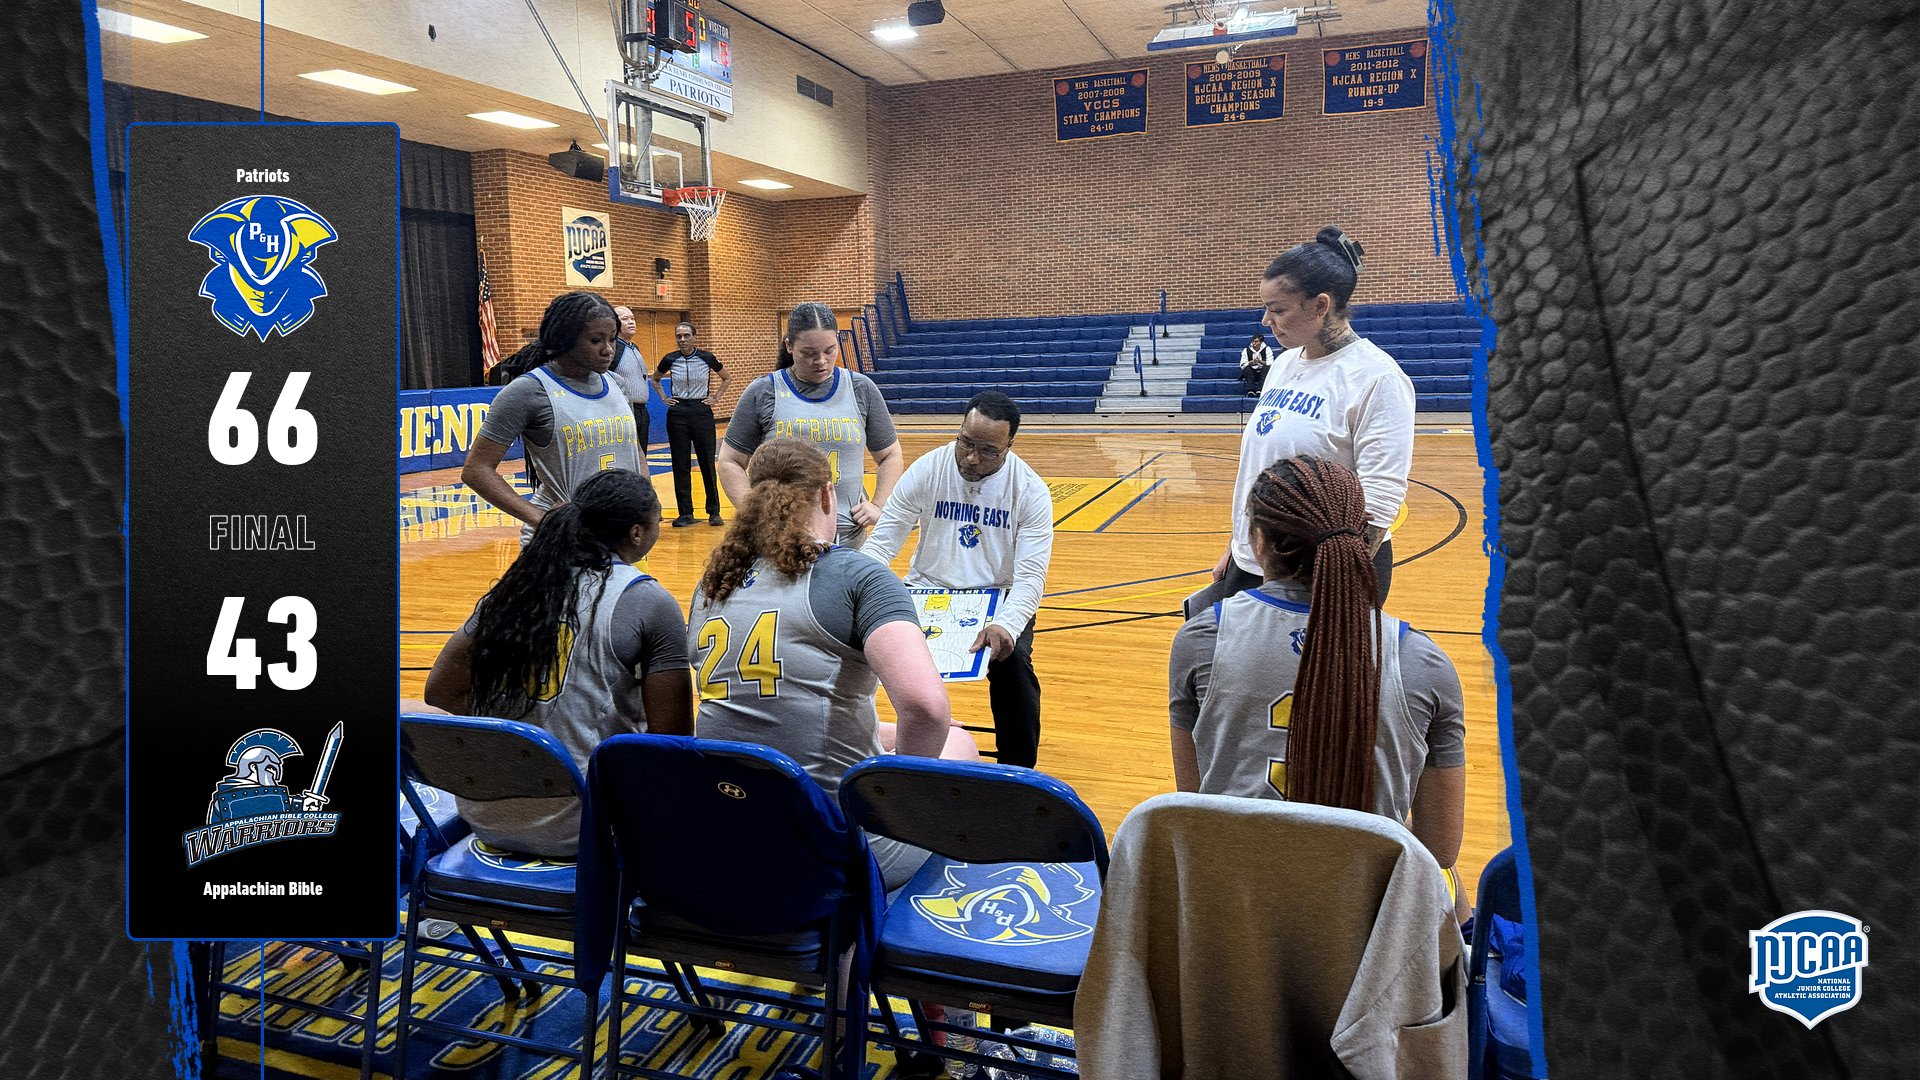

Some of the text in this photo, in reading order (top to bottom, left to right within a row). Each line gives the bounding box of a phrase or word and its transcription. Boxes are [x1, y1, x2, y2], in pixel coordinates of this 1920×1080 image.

[708, 20, 730, 39] VISITOR
[1345, 46, 1405, 61] MENS BASKETBALL
[1203, 58, 1268, 74] MENS BASKETBALL
[1350, 59, 1399, 72] 2011-2012
[1074, 76, 1127, 90] MENS BASKETBALL
[1209, 69, 1261, 82] 2008-2009
[1332, 68, 1417, 86] NJCAA REGION X
[670, 79, 721, 108] PATRIOTS
[1077, 87, 1125, 100] 2007-2008
[1194, 77, 1277, 95] NJCAA REGION X
[1347, 83, 1400, 98] RUNNER-UP
[1083, 98, 1120, 111] VCCS
[1195, 88, 1276, 105] REGULAR SEASON
[1363, 97, 1384, 108] 19-9
[1210, 100, 1261, 114] CHAMPIONS
[1063, 107, 1141, 125] STATE CHAMPIONS
[1223, 112, 1246, 122] 24-6
[1090, 122, 1114, 133] 24-10
[565, 225, 607, 260] NJCAA
[1288, 391, 1326, 420] EASY.
[400, 403, 492, 458] HENR
[775, 417, 861, 442] PATRIOTS
[934, 500, 1011, 530] NOTHING EASY.
[697, 608, 783, 701] 24
